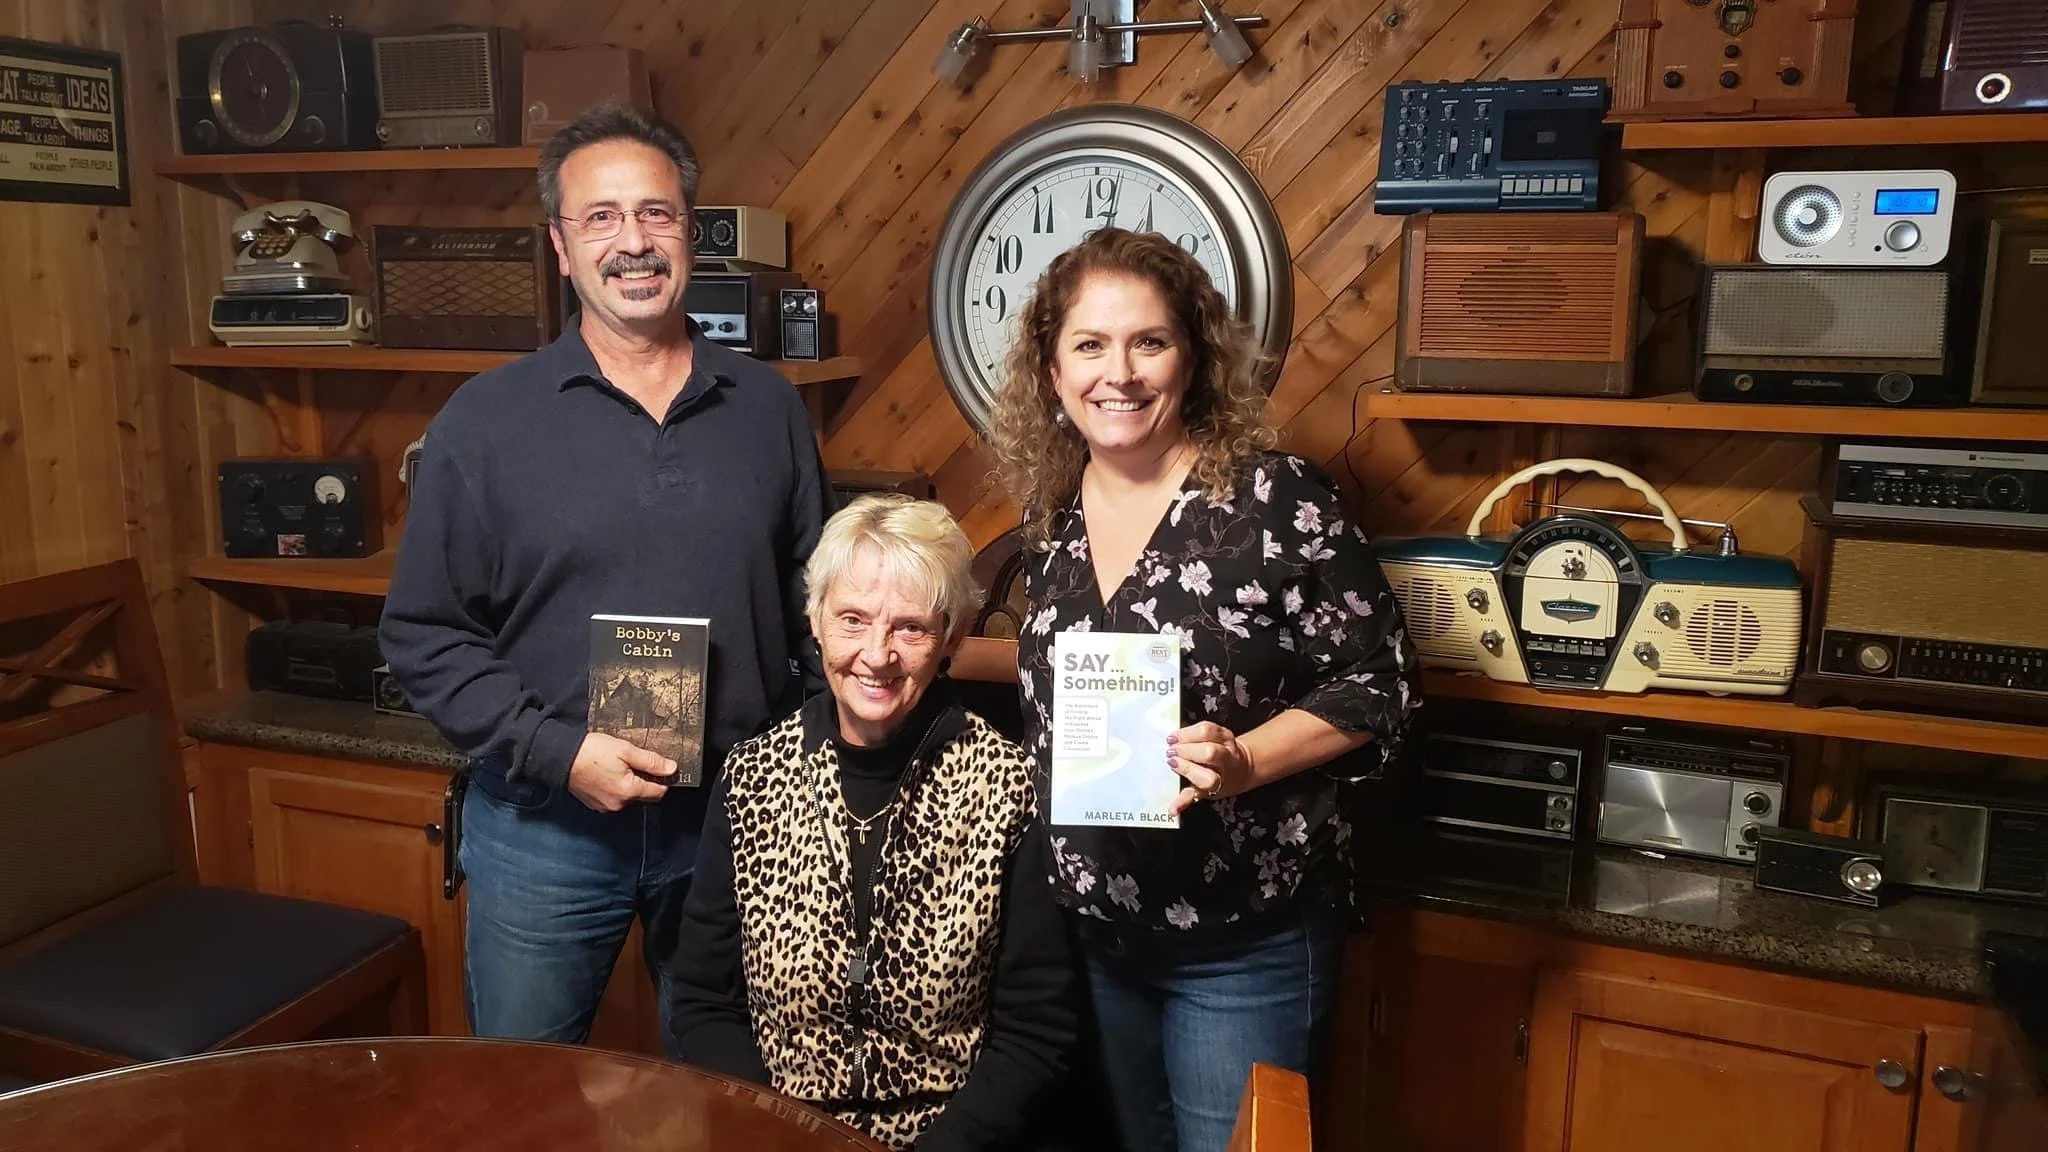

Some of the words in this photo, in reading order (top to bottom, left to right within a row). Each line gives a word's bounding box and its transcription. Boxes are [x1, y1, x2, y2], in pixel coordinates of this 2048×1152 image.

[27, 73, 56, 88] PEOPLE
[20, 89, 39, 101] TALK
[40, 92, 64, 107] ABOUT
[66, 77, 109, 112] IDEAS
[31, 116, 59, 130] PEOPLE
[24, 132, 42, 144] TALK
[43, 133, 66, 147] ABOUT
[72, 126, 110, 143] THINGS
[1027, 193, 1054, 234] 11
[992, 235, 1023, 275] 10
[985, 285, 1007, 325] 9
[1546, 602, 1588, 611] Classic
[615, 626, 681, 643] Bobby's
[622, 643, 673, 658] Cabin
[1064, 675, 1175, 696] Something!
[1084, 811, 1135, 821] MARLETA
[1139, 812, 1175, 823] BLACK
